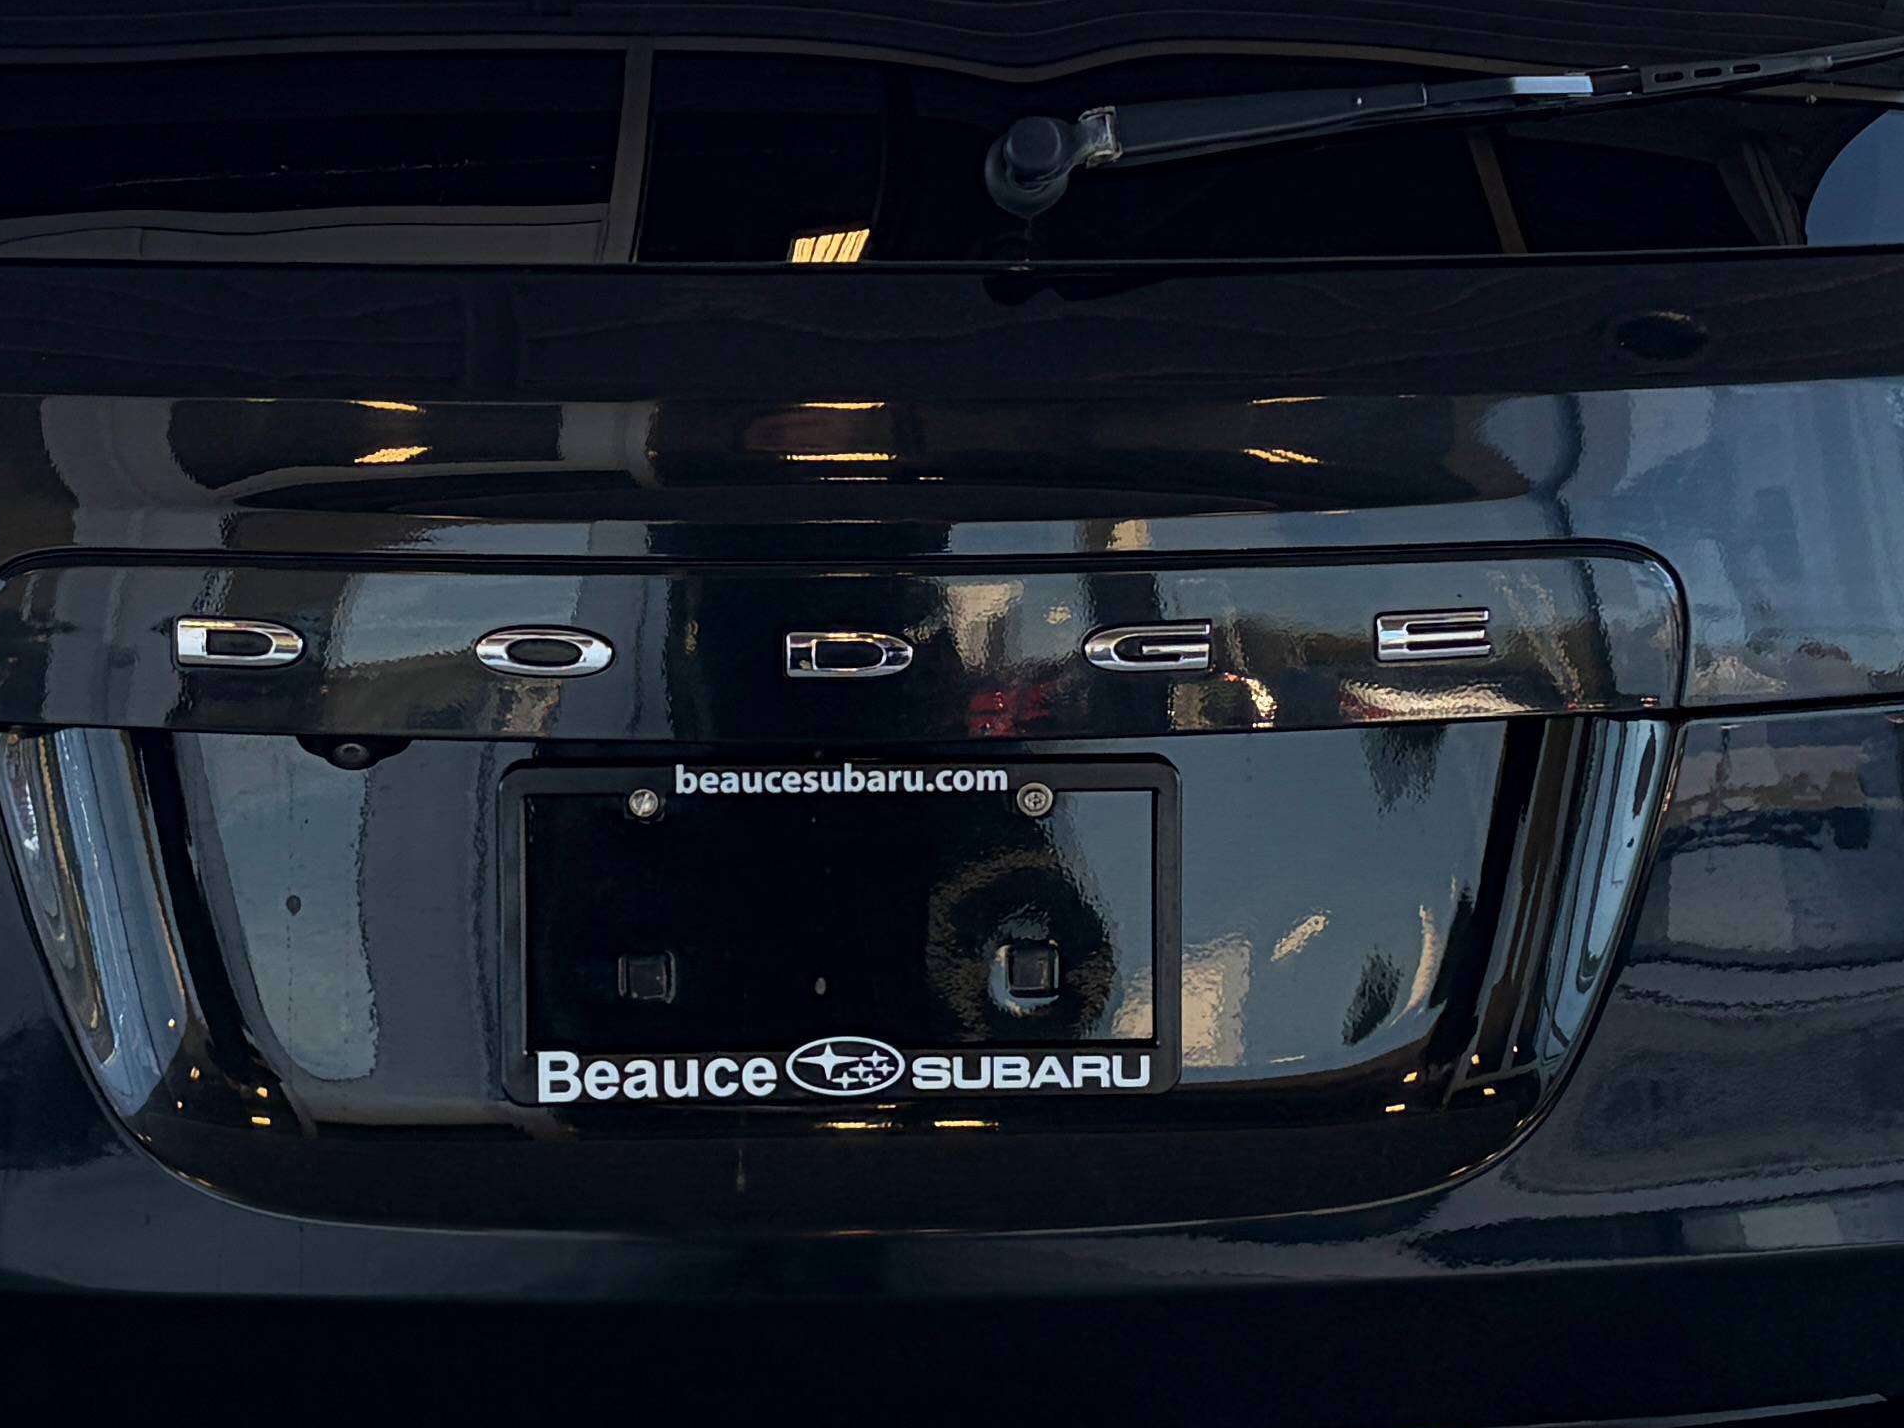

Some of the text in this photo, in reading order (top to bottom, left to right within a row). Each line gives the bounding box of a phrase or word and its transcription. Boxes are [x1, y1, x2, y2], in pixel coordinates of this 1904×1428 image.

[177, 609, 1492, 678] DODGE
[675, 763, 1009, 794] beaucesubaru.com
[537, 1051, 1151, 1103] Beauce SUBARU
